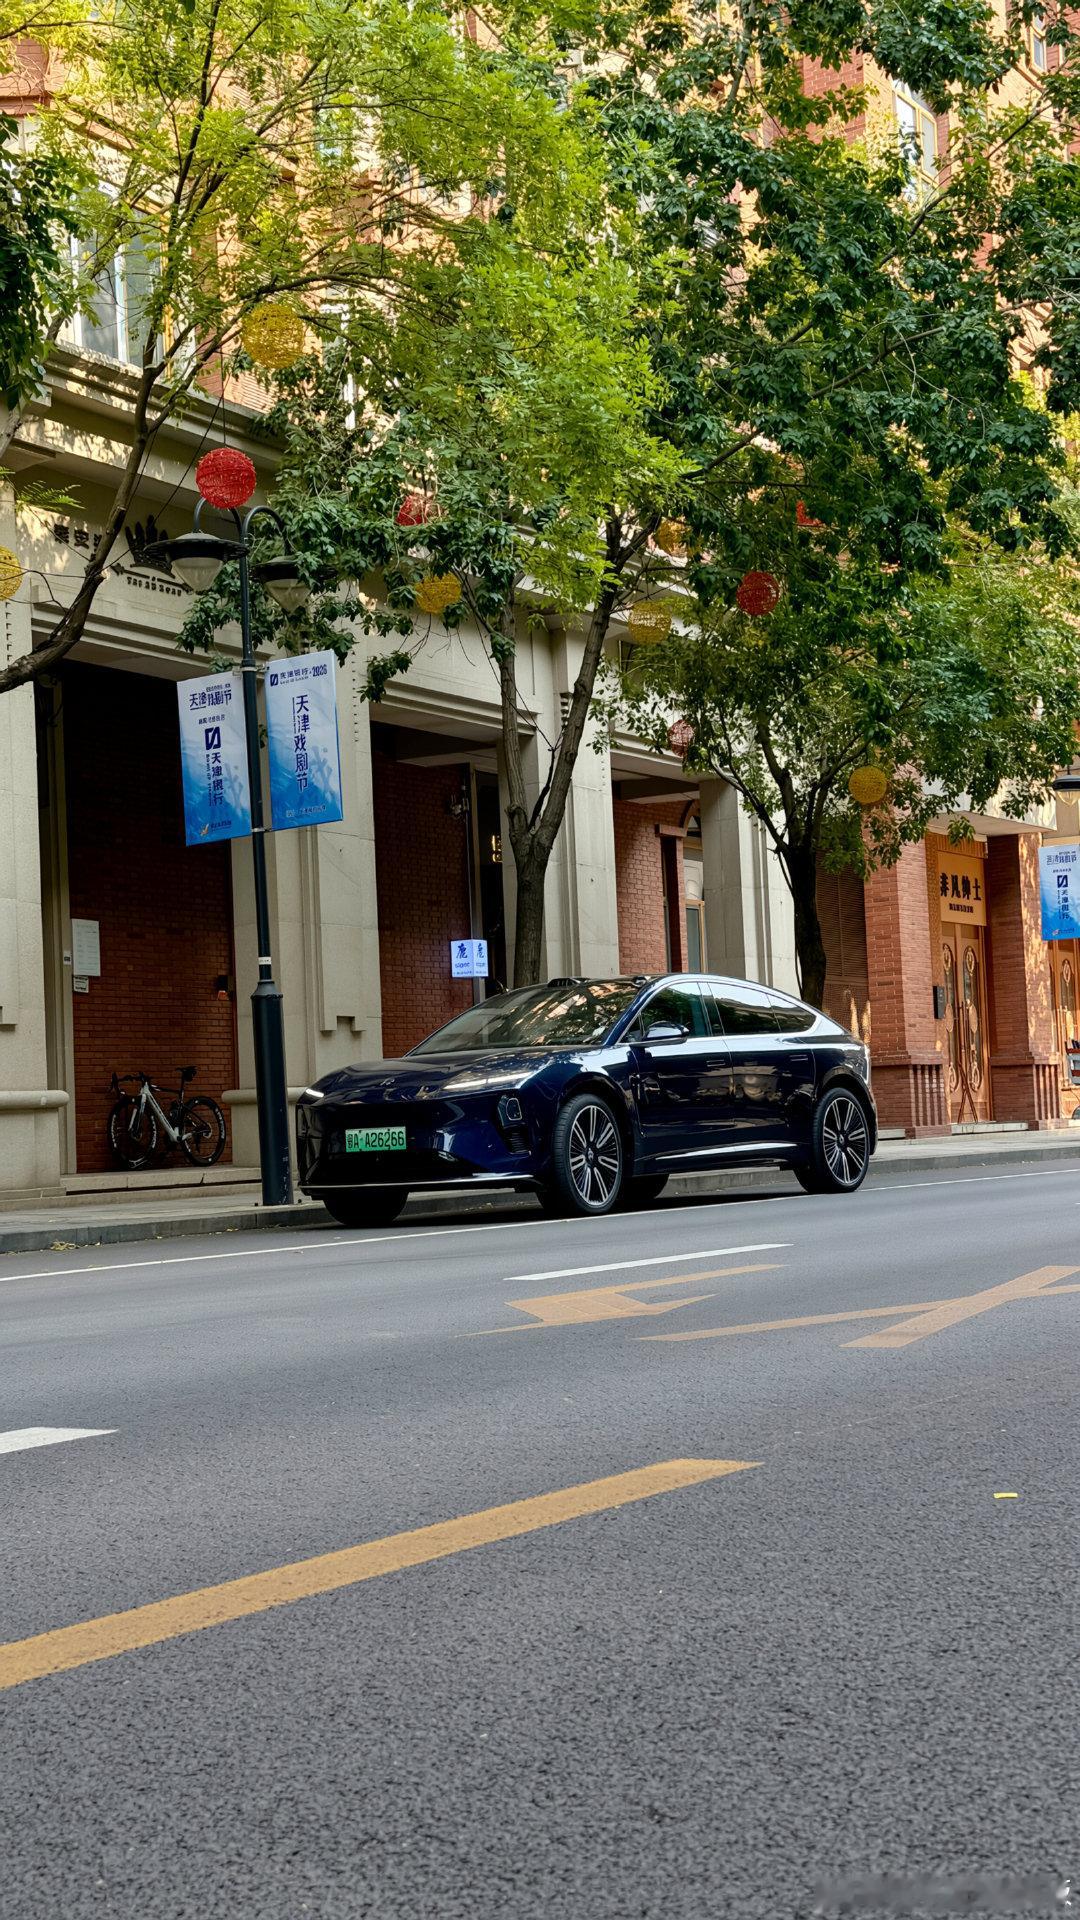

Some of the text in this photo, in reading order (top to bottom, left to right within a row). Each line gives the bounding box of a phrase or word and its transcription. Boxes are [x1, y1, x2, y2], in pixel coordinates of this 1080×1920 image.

[294, 694, 311, 793] 天津戏剧节
